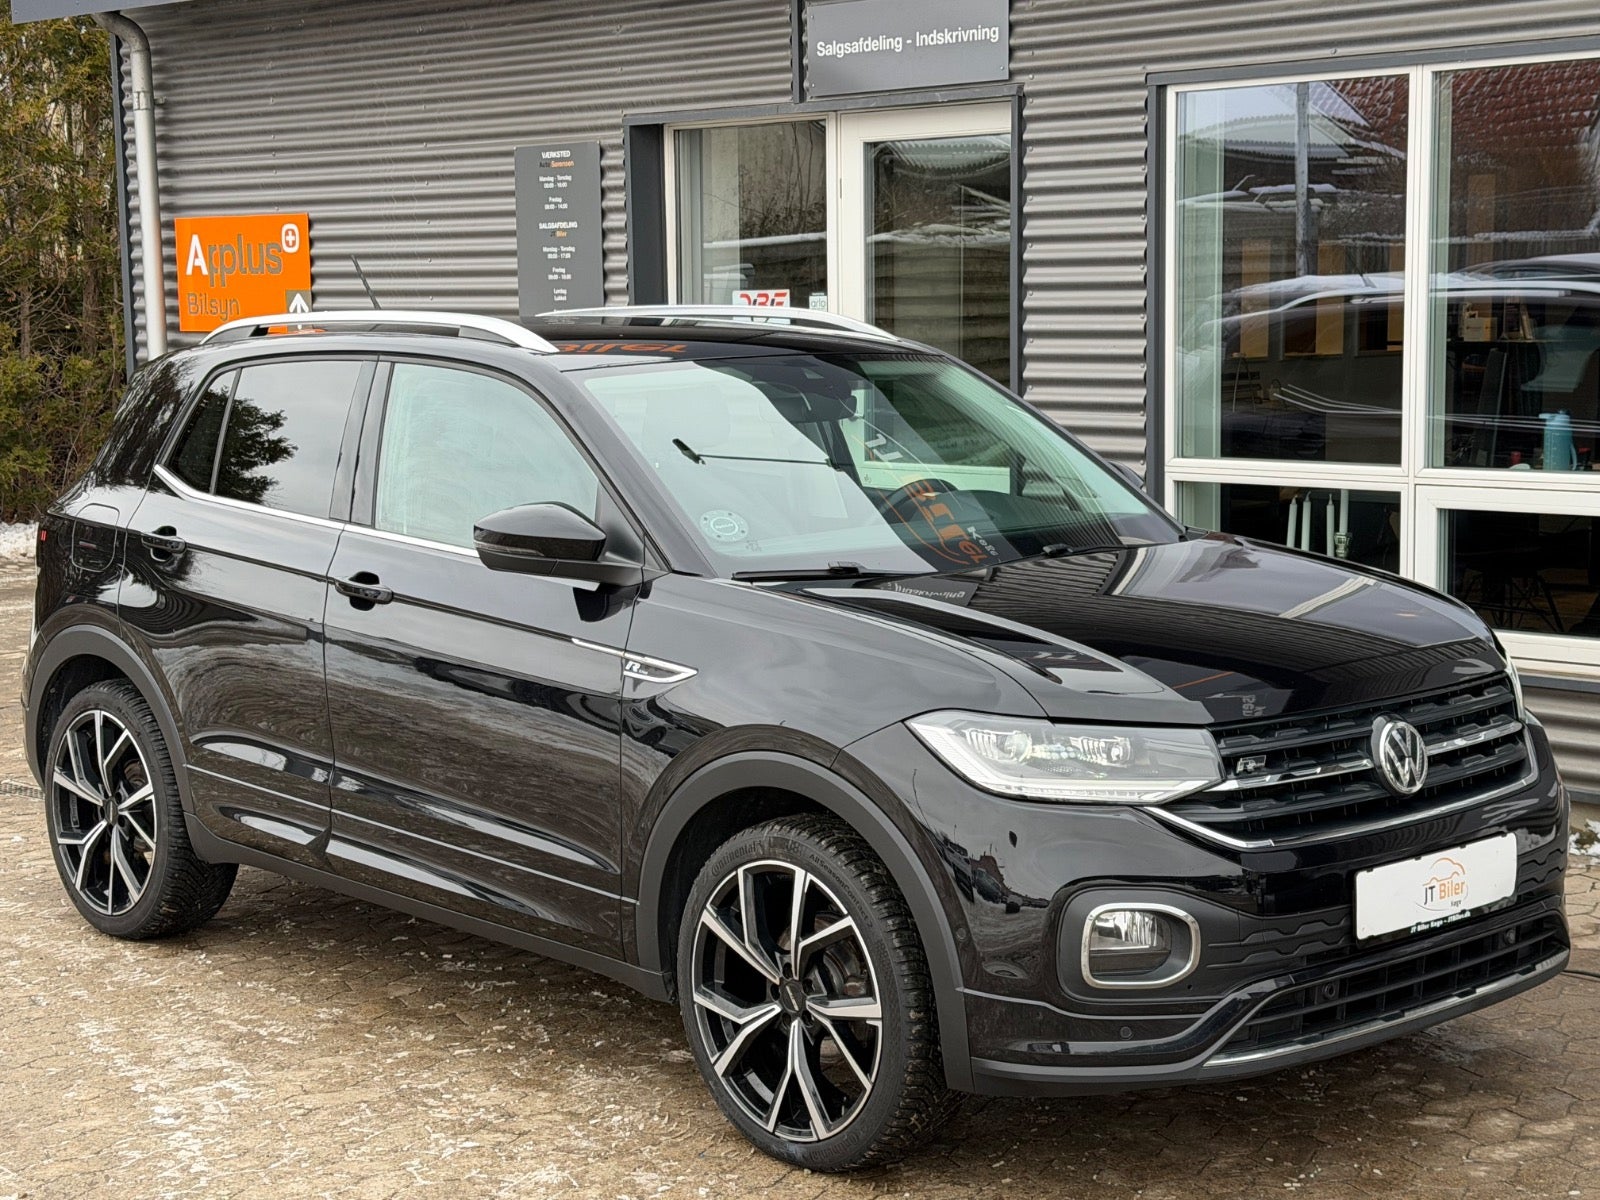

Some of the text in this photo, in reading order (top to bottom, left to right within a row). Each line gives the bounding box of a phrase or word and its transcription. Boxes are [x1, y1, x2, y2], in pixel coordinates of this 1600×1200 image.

[816, 35, 903, 58] Salgsafdeling
[916, 25, 1000, 47] Indskrivning
[187, 293, 240, 321] Bilsyn
[1424, 880, 1466, 905] JT Biler
